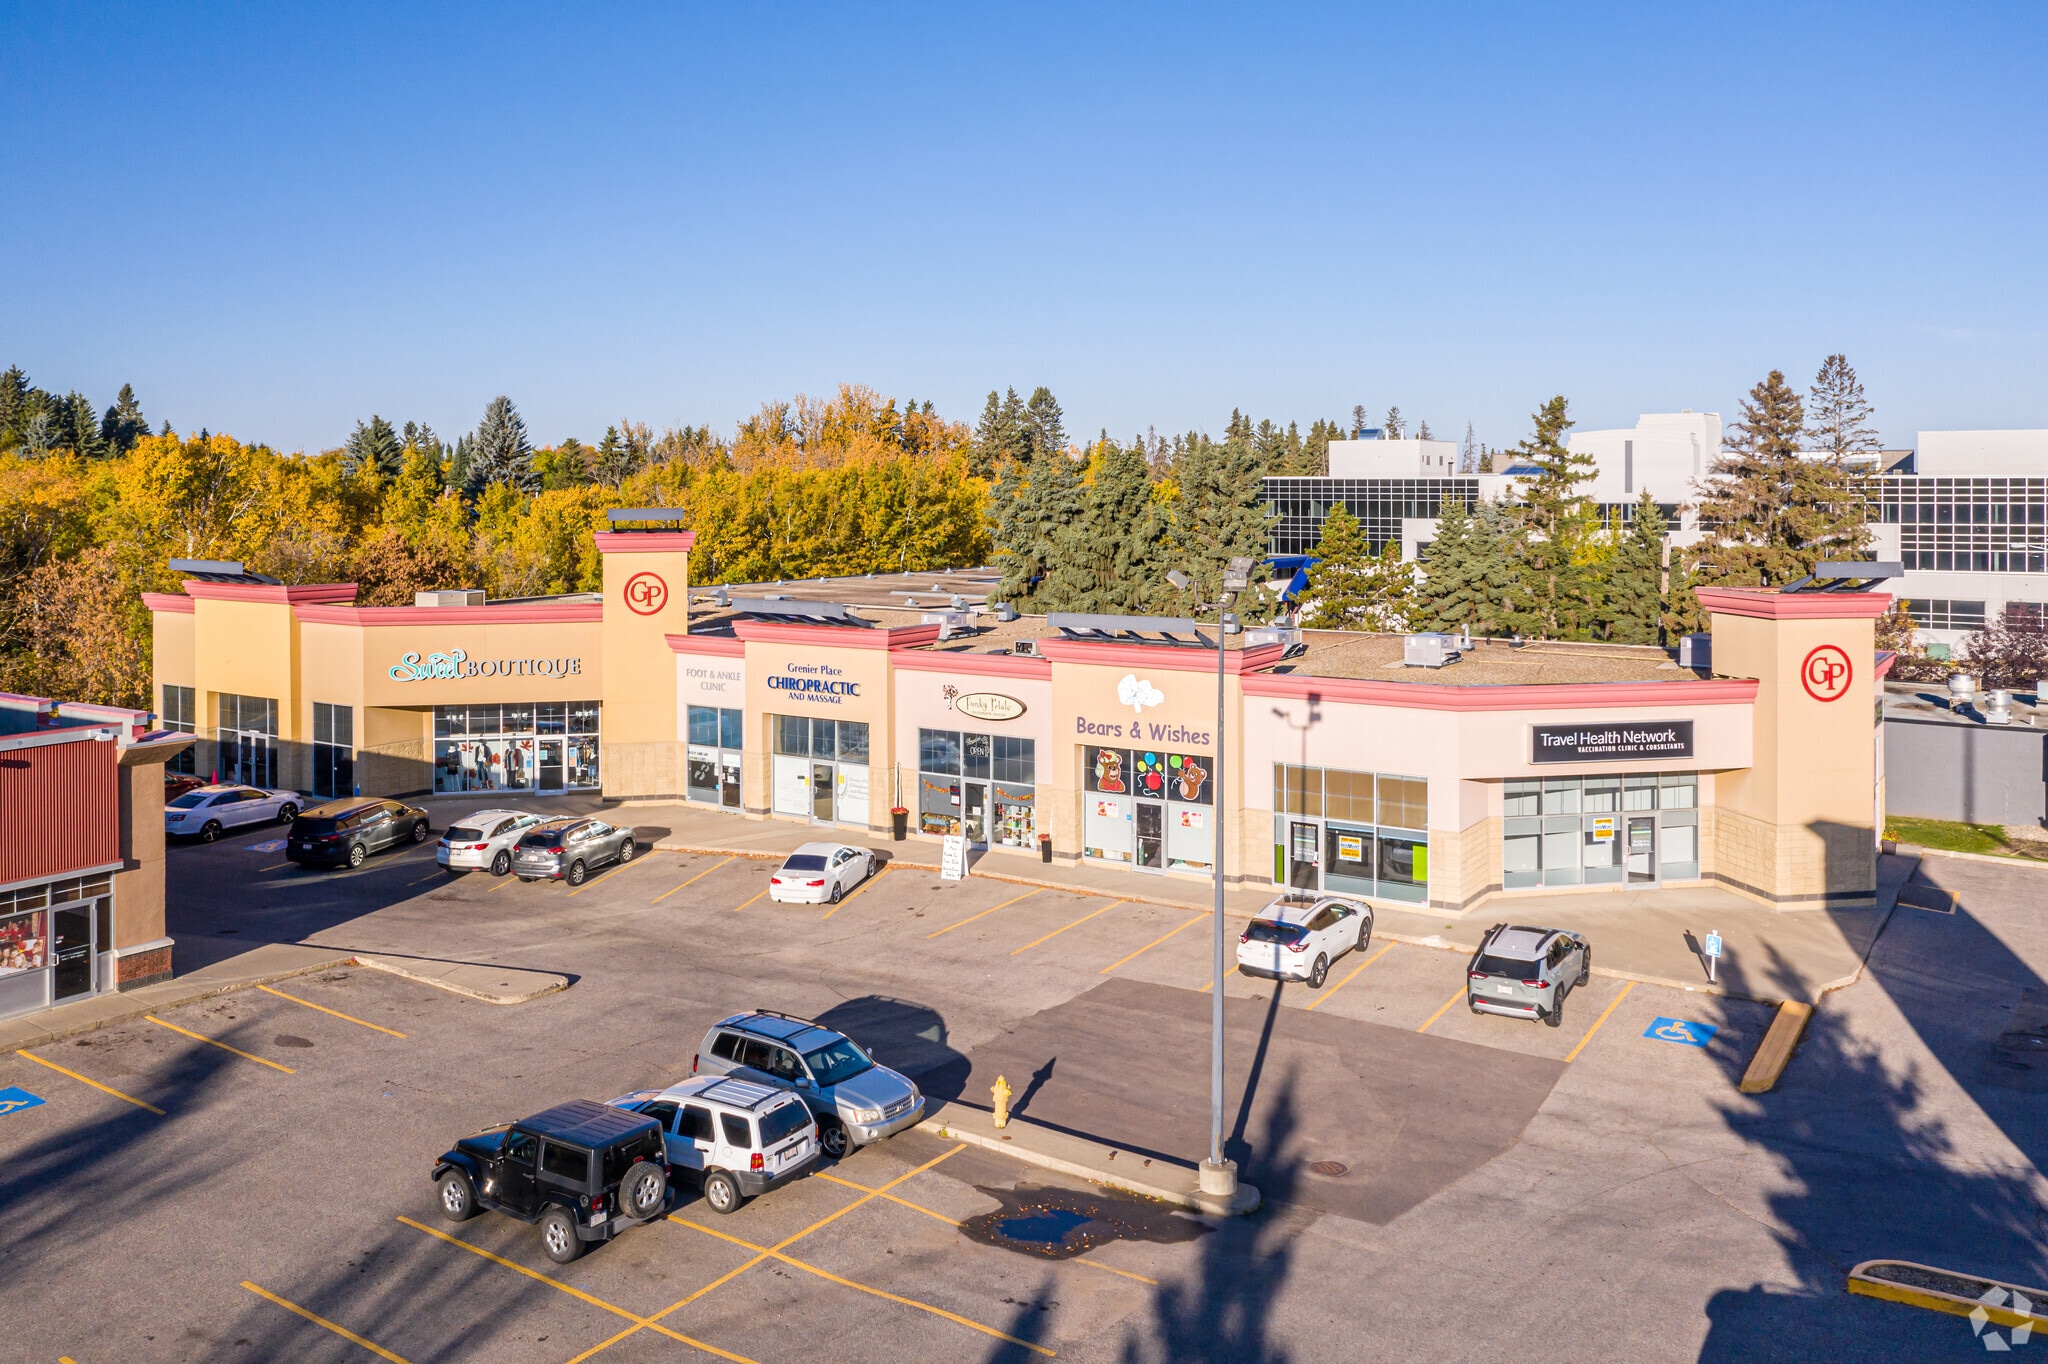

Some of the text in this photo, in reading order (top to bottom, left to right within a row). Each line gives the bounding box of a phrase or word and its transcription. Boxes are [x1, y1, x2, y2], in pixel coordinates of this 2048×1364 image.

[389, 648, 581, 682] Sweet BOUTIQUE
[787, 663, 842, 676] Grenier Place
[686, 668, 741, 681] FOOT & ANKLE
[700, 681, 727, 692] CLINIC
[767, 675, 861, 697] CHIROPRACTIC
[788, 692, 842, 704] AND MASSAGE
[1076, 716, 1210, 745] Bears & Wishes
[1540, 729, 1676, 746] Travel Health Network
[970, 746, 985, 756] OPEN
[1577, 745, 1616, 753] VACCINATION
[1618, 744, 1638, 752] CLINIC
[1645, 742, 1685, 751] CONSULTANTS
